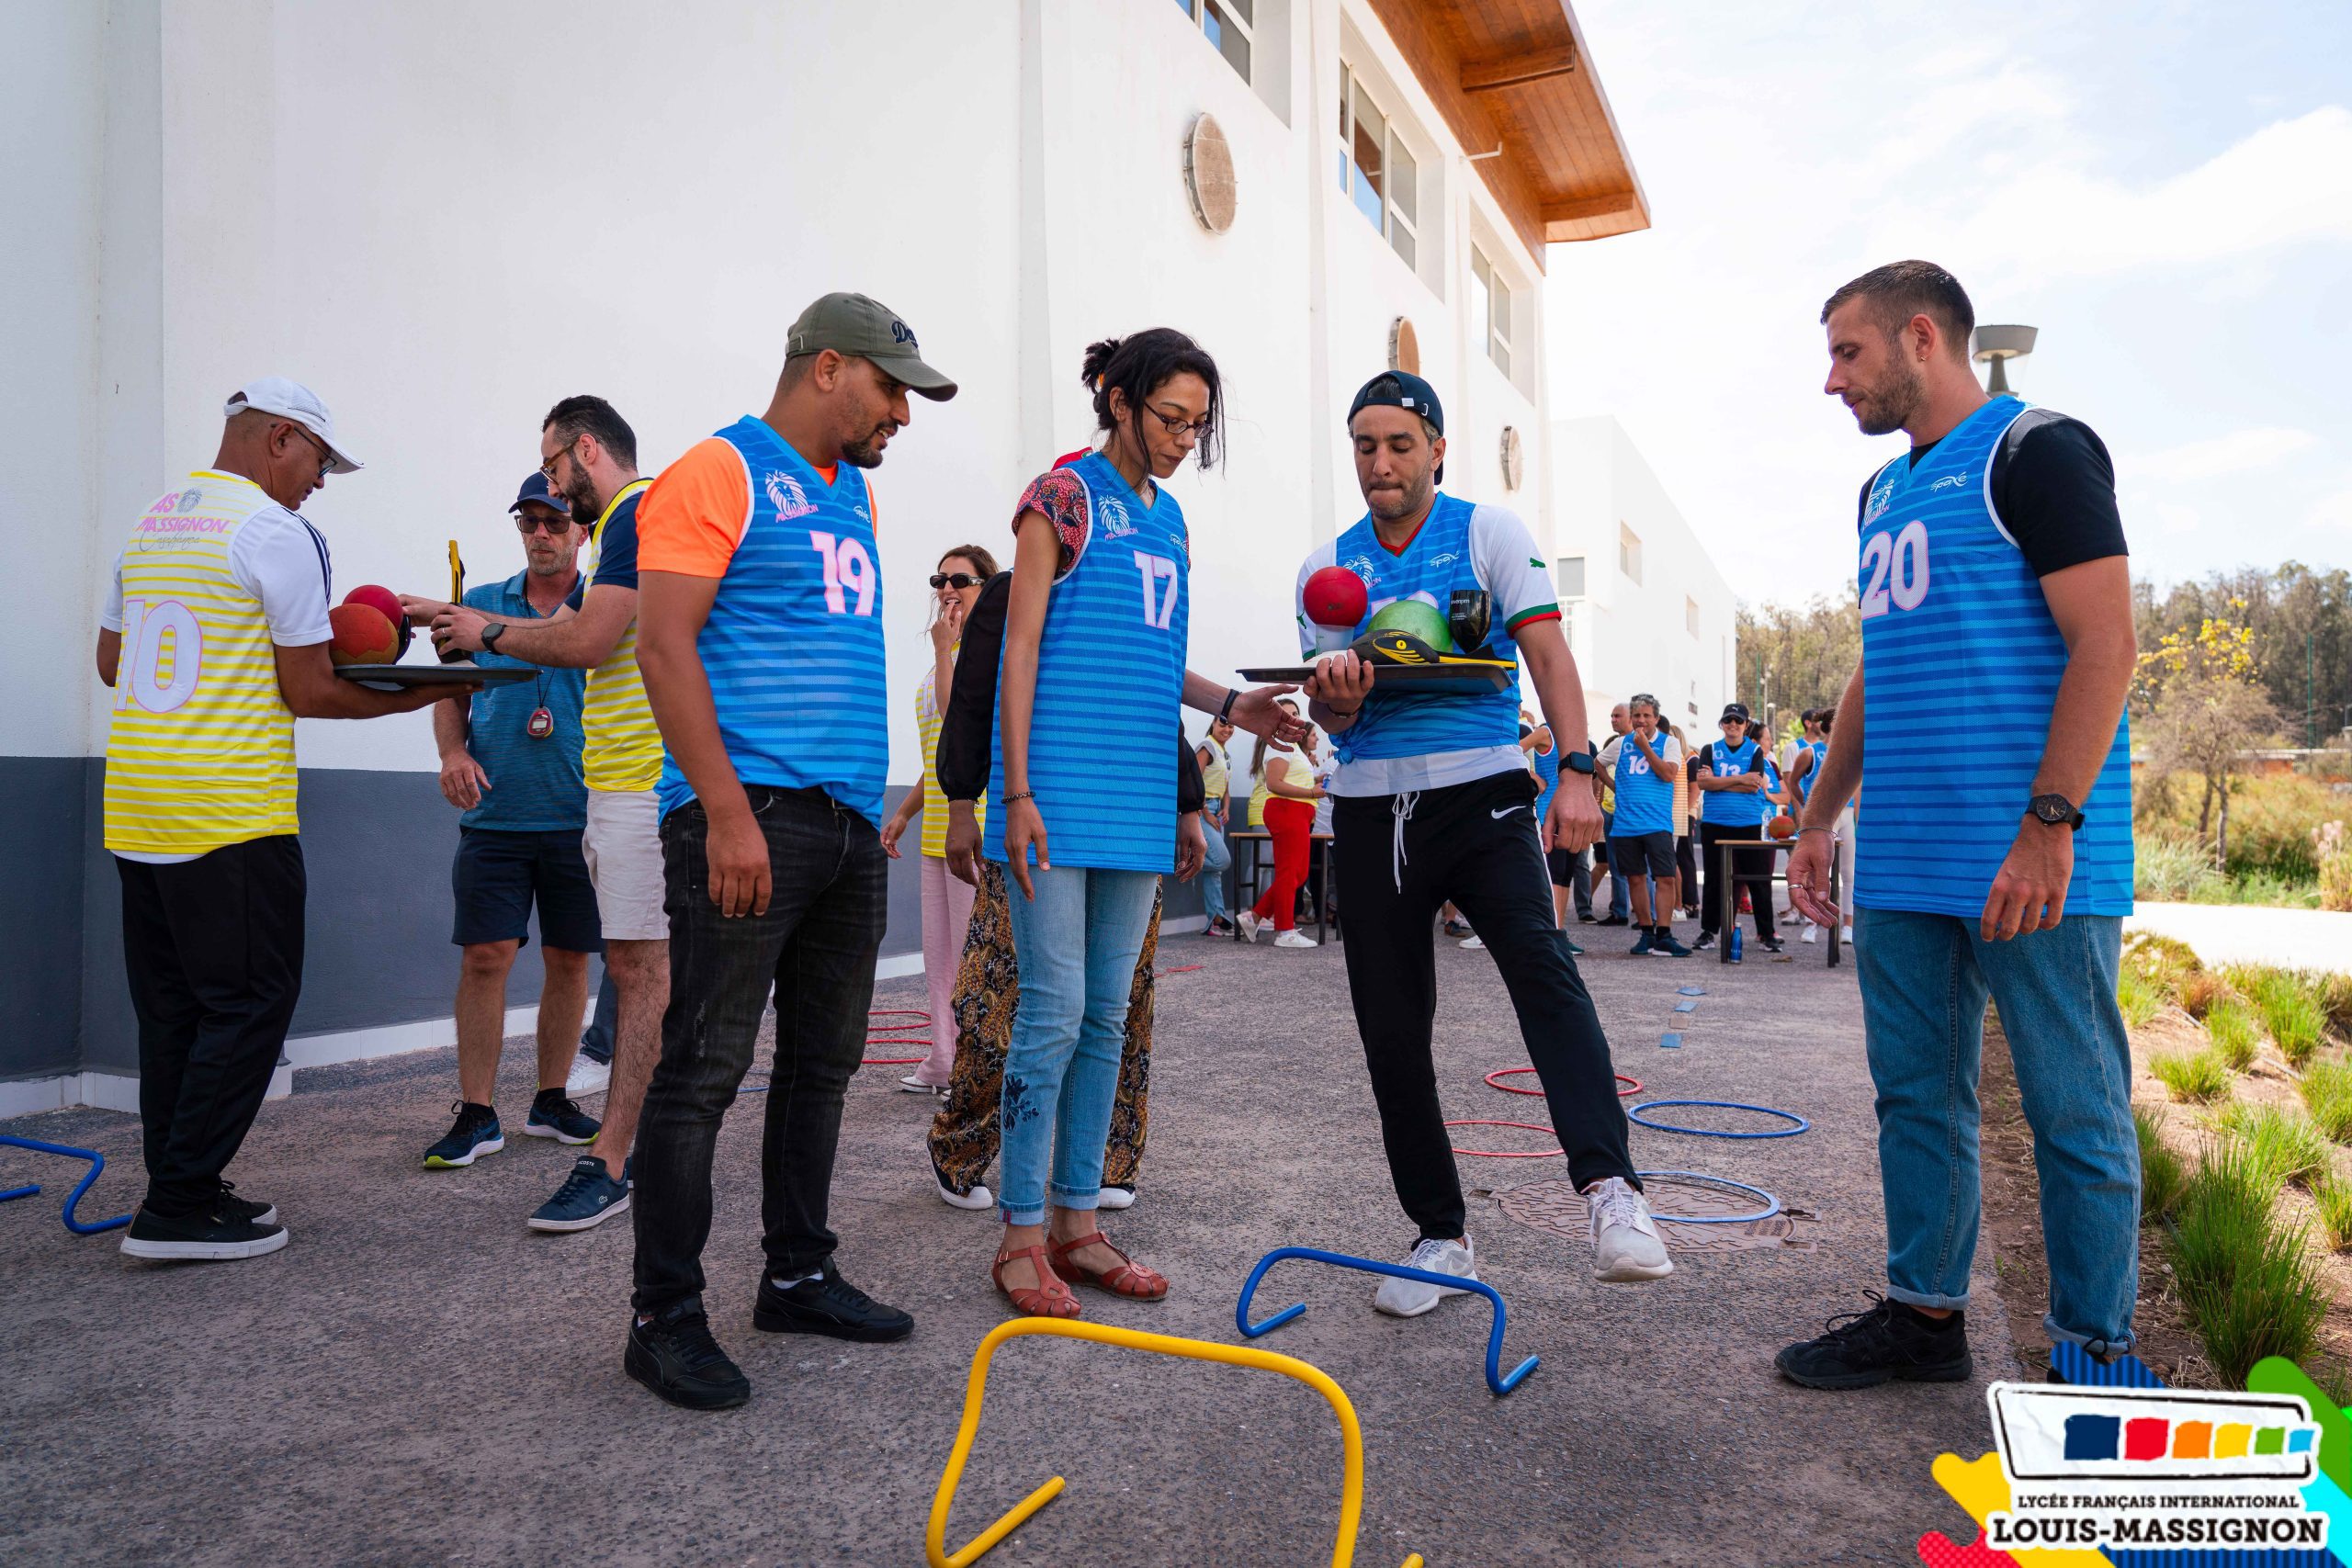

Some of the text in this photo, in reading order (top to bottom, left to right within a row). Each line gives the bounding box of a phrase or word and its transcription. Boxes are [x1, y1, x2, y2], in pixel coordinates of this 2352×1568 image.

[134, 516, 230, 534] MASSIGNON
[149, 492, 180, 513] AS
[809, 530, 876, 617] 19
[1133, 549, 1178, 631] 17
[1860, 520, 1930, 621] 20
[115, 599, 203, 714] 10
[1628, 755, 1650, 775] 16
